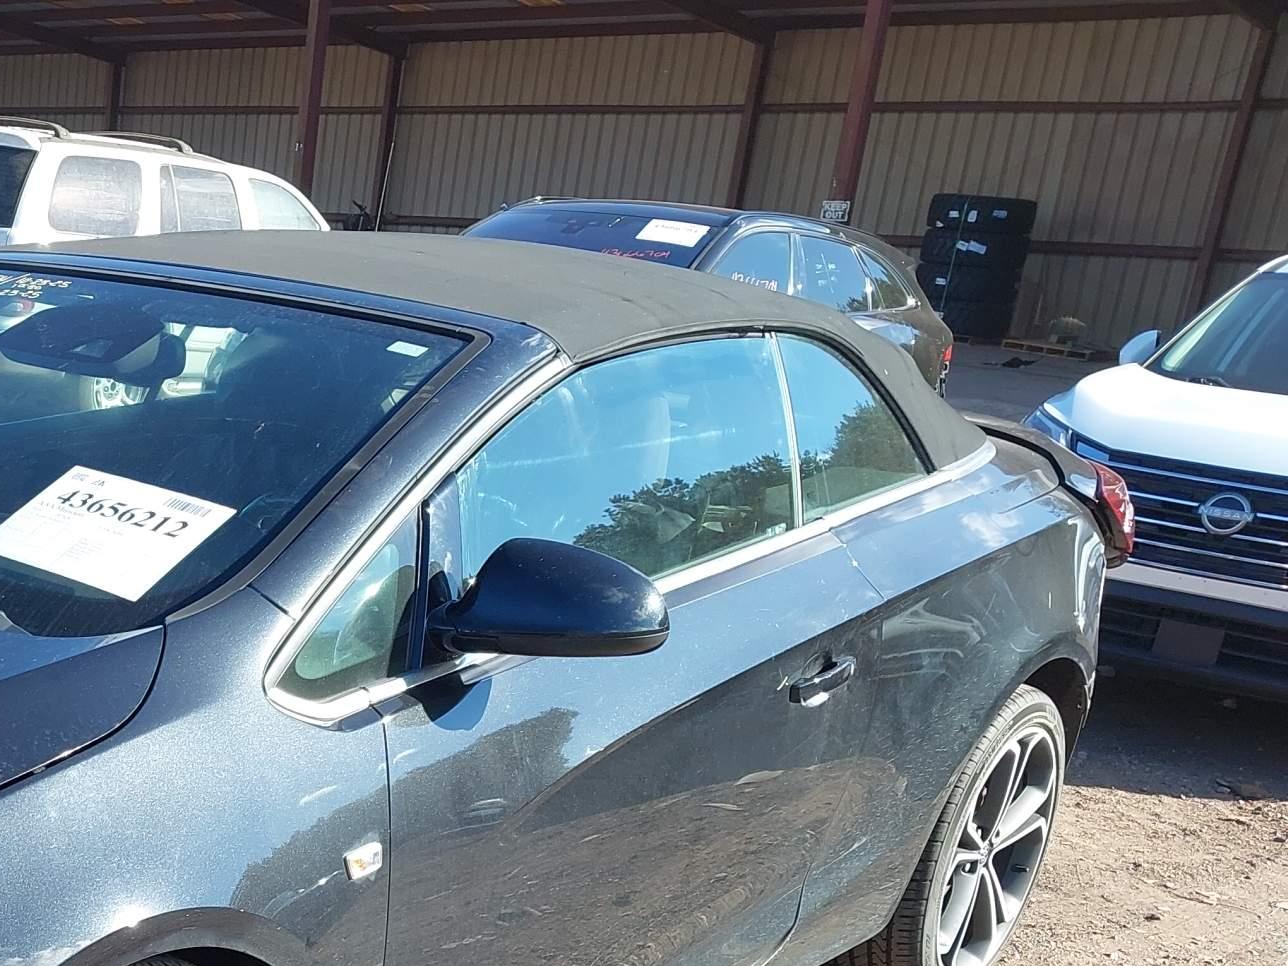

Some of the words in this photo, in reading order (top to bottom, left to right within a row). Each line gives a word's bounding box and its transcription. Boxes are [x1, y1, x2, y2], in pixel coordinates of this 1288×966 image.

[823, 203, 847, 211] KEEP
[824, 211, 844, 219] OUT
[56, 489, 189, 538] 43656212
[1198, 504, 1254, 522] NISSAN
